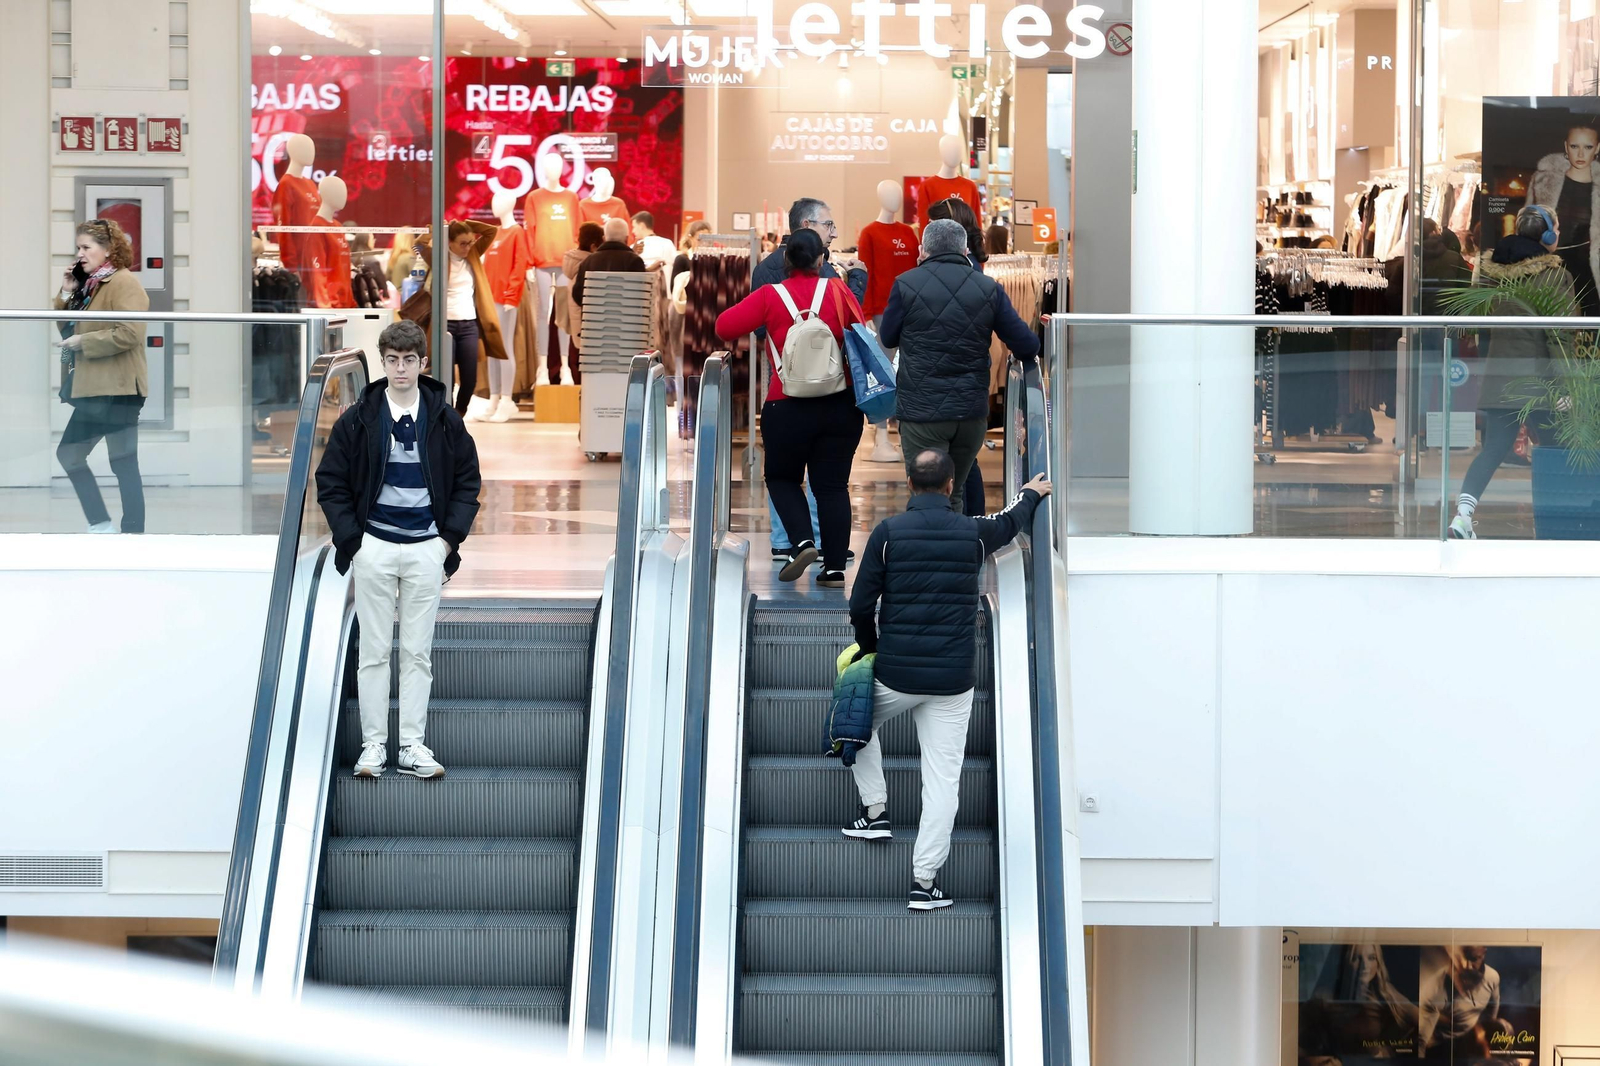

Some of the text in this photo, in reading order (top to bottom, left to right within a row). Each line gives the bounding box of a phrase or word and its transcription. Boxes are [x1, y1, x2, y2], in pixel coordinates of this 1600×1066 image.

[757, 0, 1107, 59] lefties
[1367, 55, 1393, 70] PR
[688, 73, 744, 84] WOMAN
[466, 84, 614, 112] REBAJAS
[785, 117, 874, 133] CAJAS DE
[889, 118, 938, 133] CAJA
[474, 135, 492, 159] 4
[771, 135, 889, 151] AUTOCOBRO
[1517, 1029, 1536, 1044] Cain
